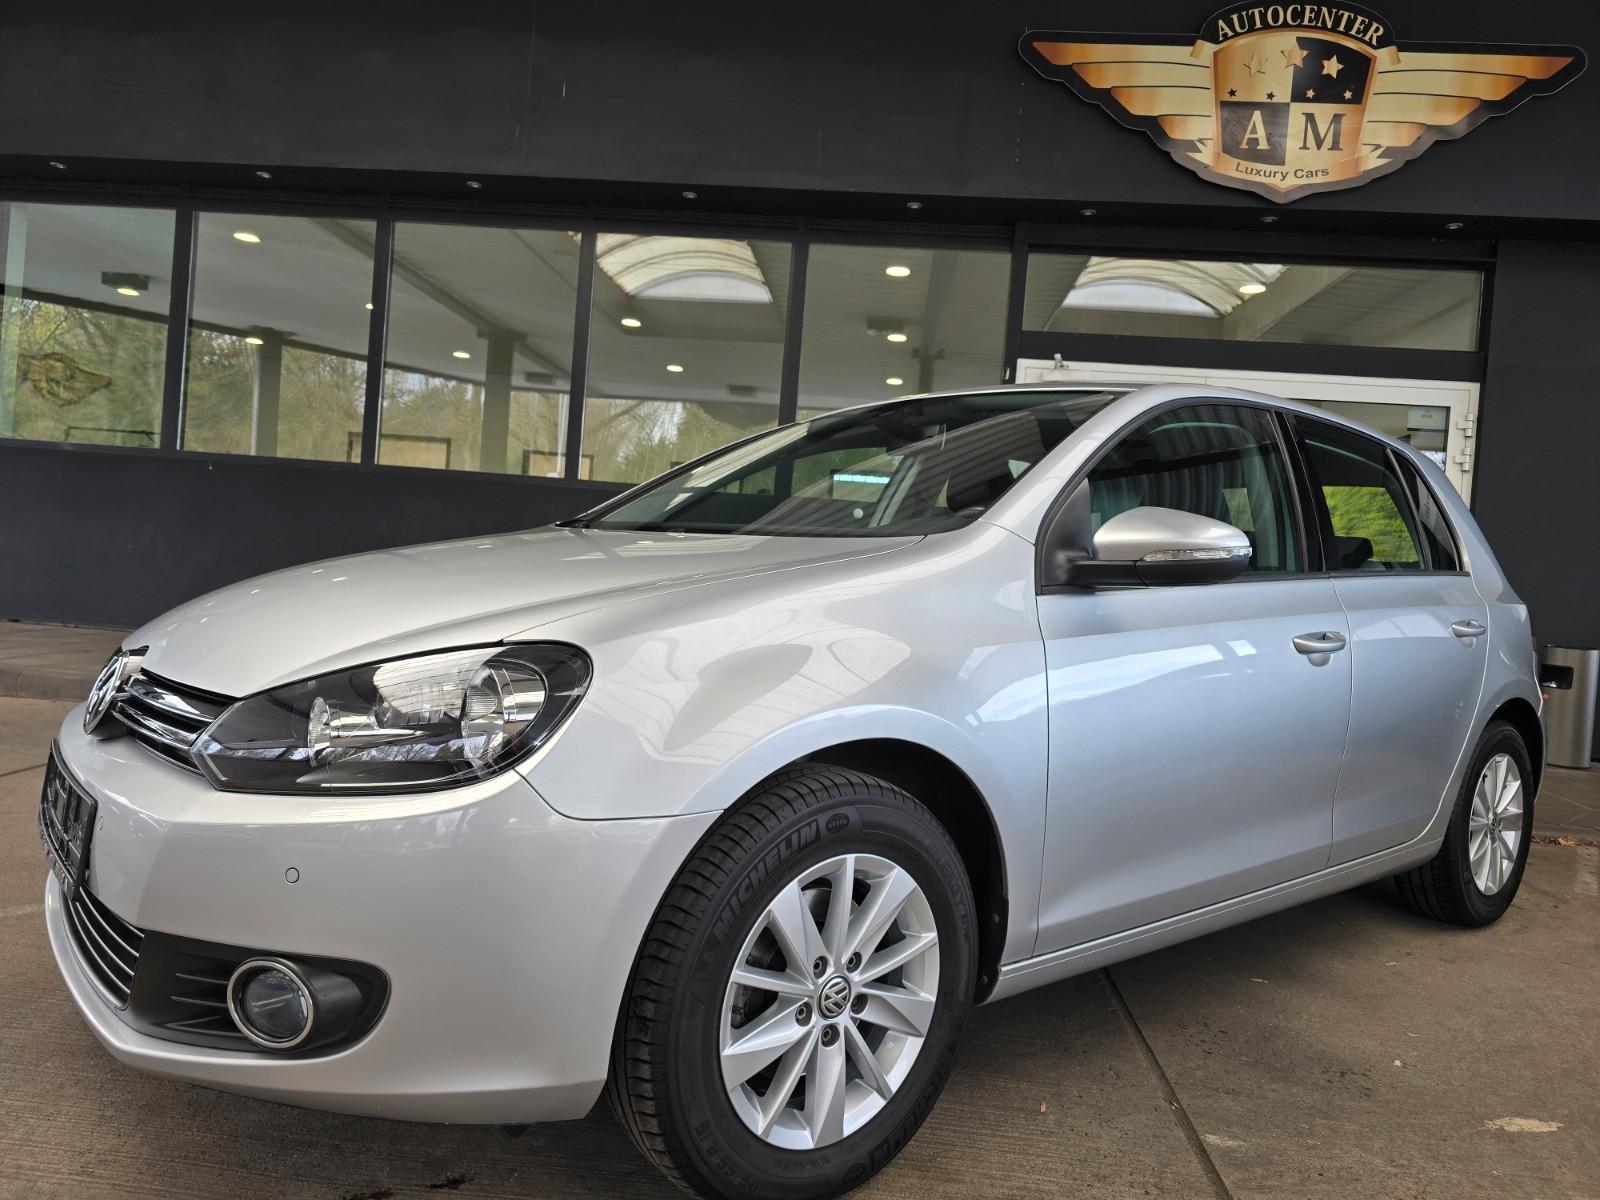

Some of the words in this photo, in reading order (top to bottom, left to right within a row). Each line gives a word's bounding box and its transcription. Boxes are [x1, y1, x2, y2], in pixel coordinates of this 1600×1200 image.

[1217, 4, 1384, 46] AUTOCENTER
[1239, 110, 1271, 150] A
[1298, 112, 1346, 151] M
[1235, 161, 1289, 182] Luxury
[1293, 166, 1330, 179] Cars
[712, 820, 820, 943] MICHELIN
